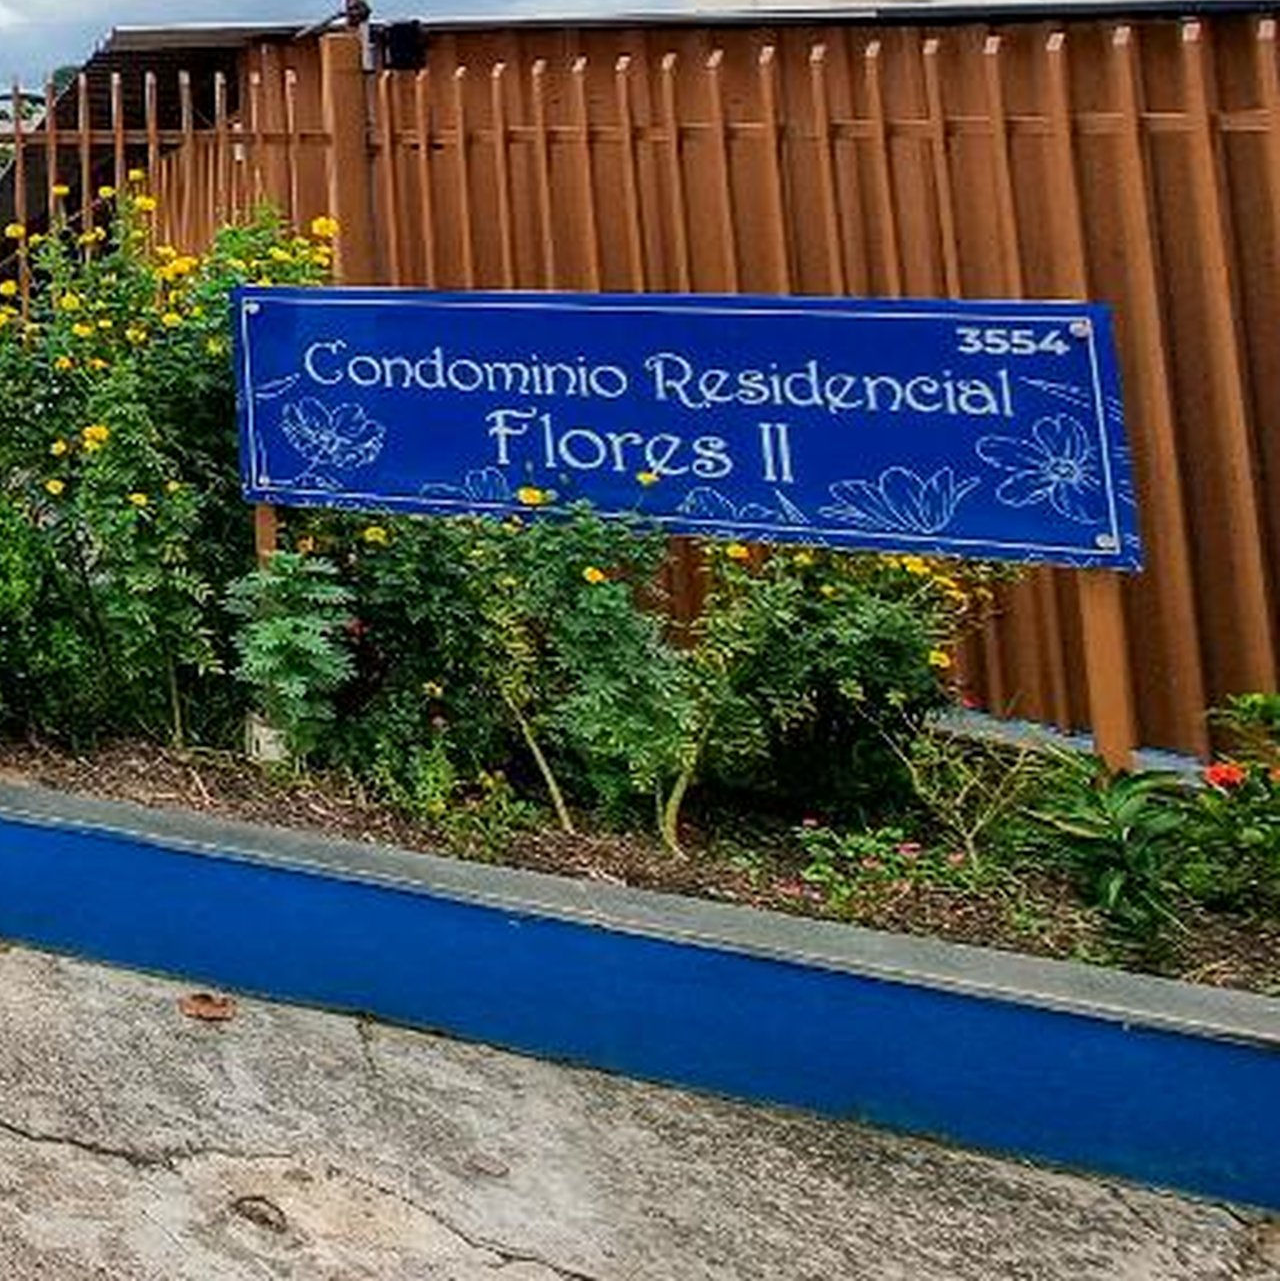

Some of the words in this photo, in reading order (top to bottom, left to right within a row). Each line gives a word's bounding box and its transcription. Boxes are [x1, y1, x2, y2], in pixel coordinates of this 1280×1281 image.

[304, 339, 628, 399] Condominio
[643, 351, 1015, 418] Residencial
[956, 327, 1072, 356] 3554
[485, 406, 735, 481] Flores
